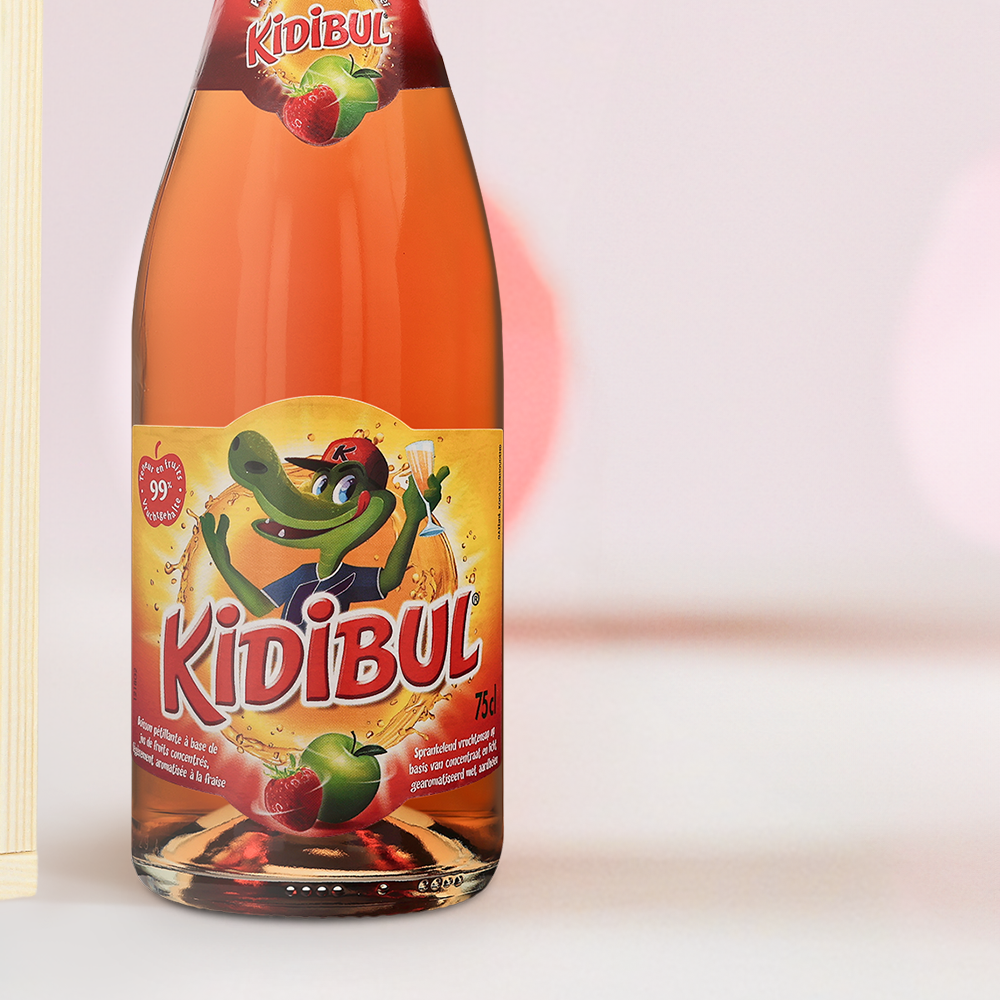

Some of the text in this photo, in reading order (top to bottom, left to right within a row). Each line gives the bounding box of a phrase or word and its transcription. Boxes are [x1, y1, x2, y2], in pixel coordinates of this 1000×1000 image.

[332, 444, 357, 462] K
[156, 465, 164, 474] en
[164, 459, 183, 480] fruits
[149, 479, 173, 501] 99%
[475, 683, 497, 720] 75cl
[146, 736, 153, 749] de
[153, 740, 170, 756] fruits
[153, 725, 182, 745] pétillante
[183, 735, 189, 747] à
[190, 737, 207, 752] base
[208, 742, 218, 755] de
[413, 738, 457, 760] Sprankelend
[408, 762, 429, 775] basis
[429, 761, 444, 772] van
[445, 747, 481, 769] concentraat
[189, 769, 195, 780] à
[195, 770, 203, 783] la
[204, 772, 227, 788] fraise
[409, 767, 465, 793] gearomatiseerd
[465, 764, 477, 777] met
